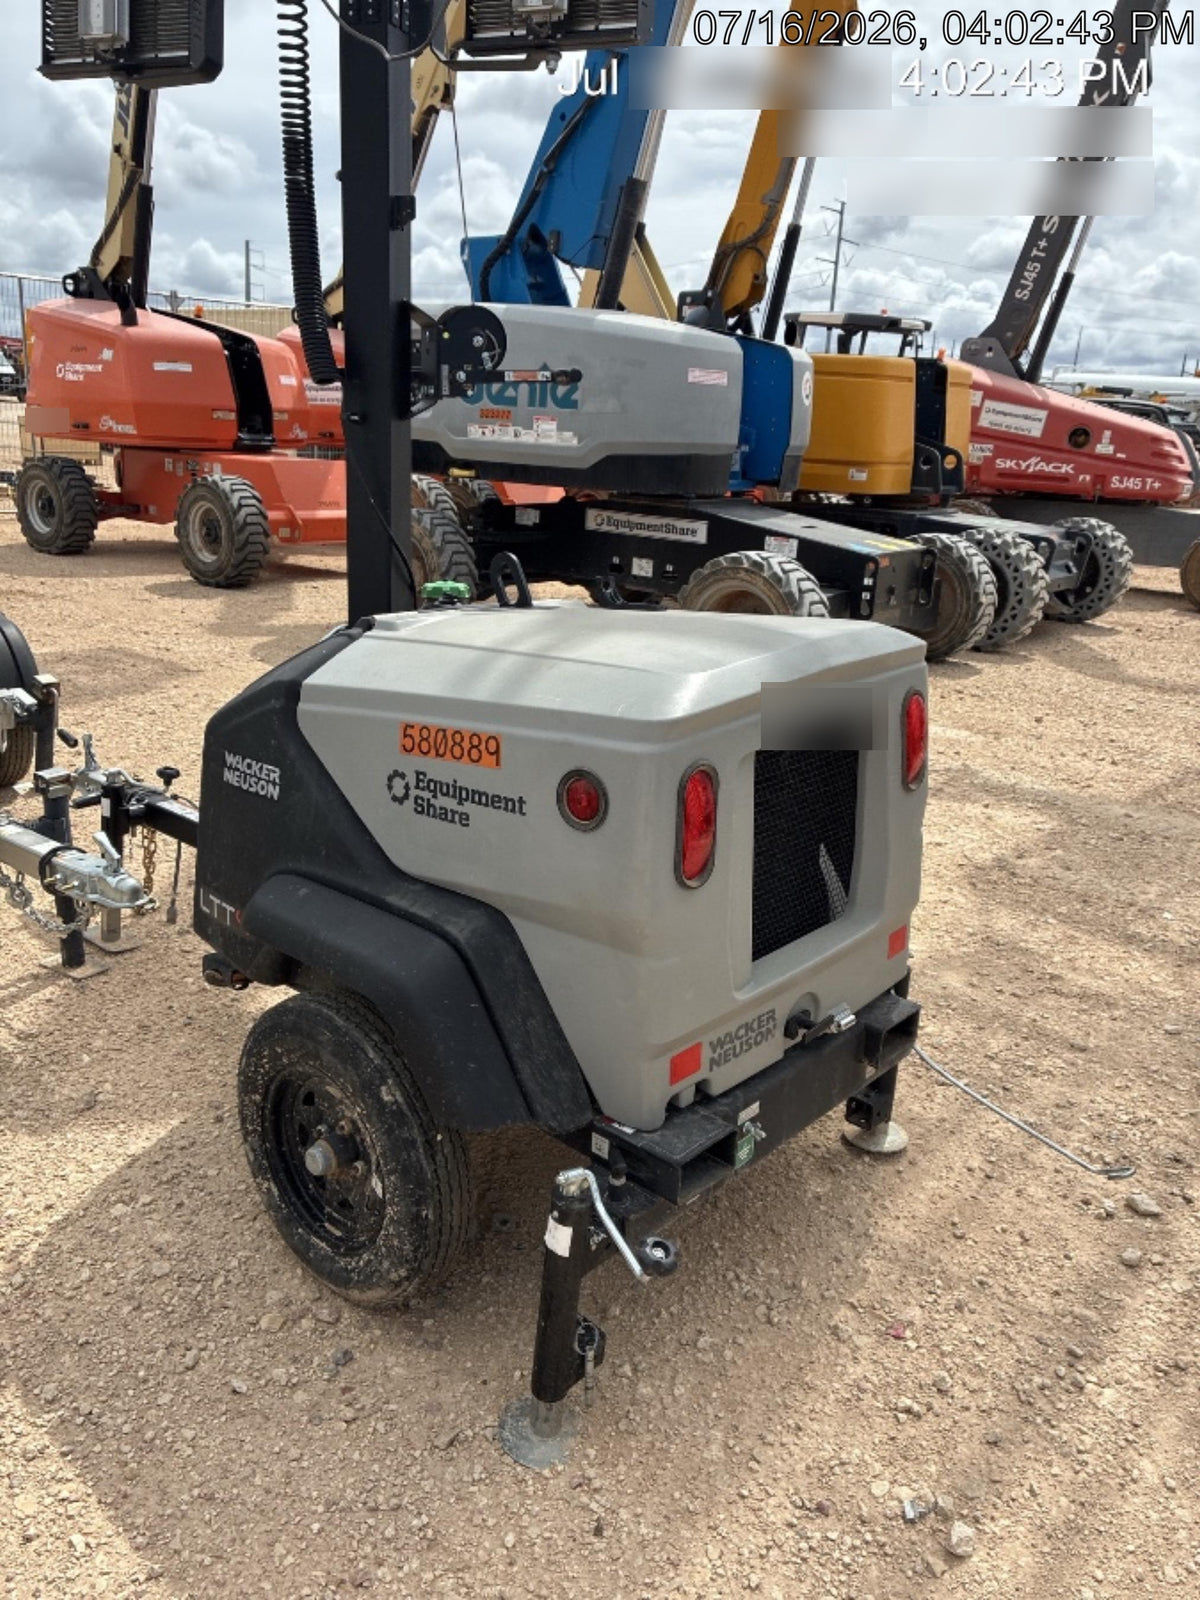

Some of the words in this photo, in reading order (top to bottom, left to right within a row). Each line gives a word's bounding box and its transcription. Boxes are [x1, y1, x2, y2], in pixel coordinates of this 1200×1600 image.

[1014, 262, 1041, 301] SJ45
[1031, 237, 1049, 257] T+
[995, 457, 1075, 474] SKYJACK
[1110, 475, 1143, 490] SJ45
[1144, 477, 1162, 491] T+
[606, 516, 699, 538] EquipmentShare
[401, 723, 501, 767] 580889
[223, 766, 280, 801] NEUSON
[224, 749, 281, 785] WACKER
[413, 769, 527, 816] Equipment
[413, 794, 471, 828] Share
[708, 1008, 777, 1055] WACKER
[708, 1027, 776, 1073] NEUSON
